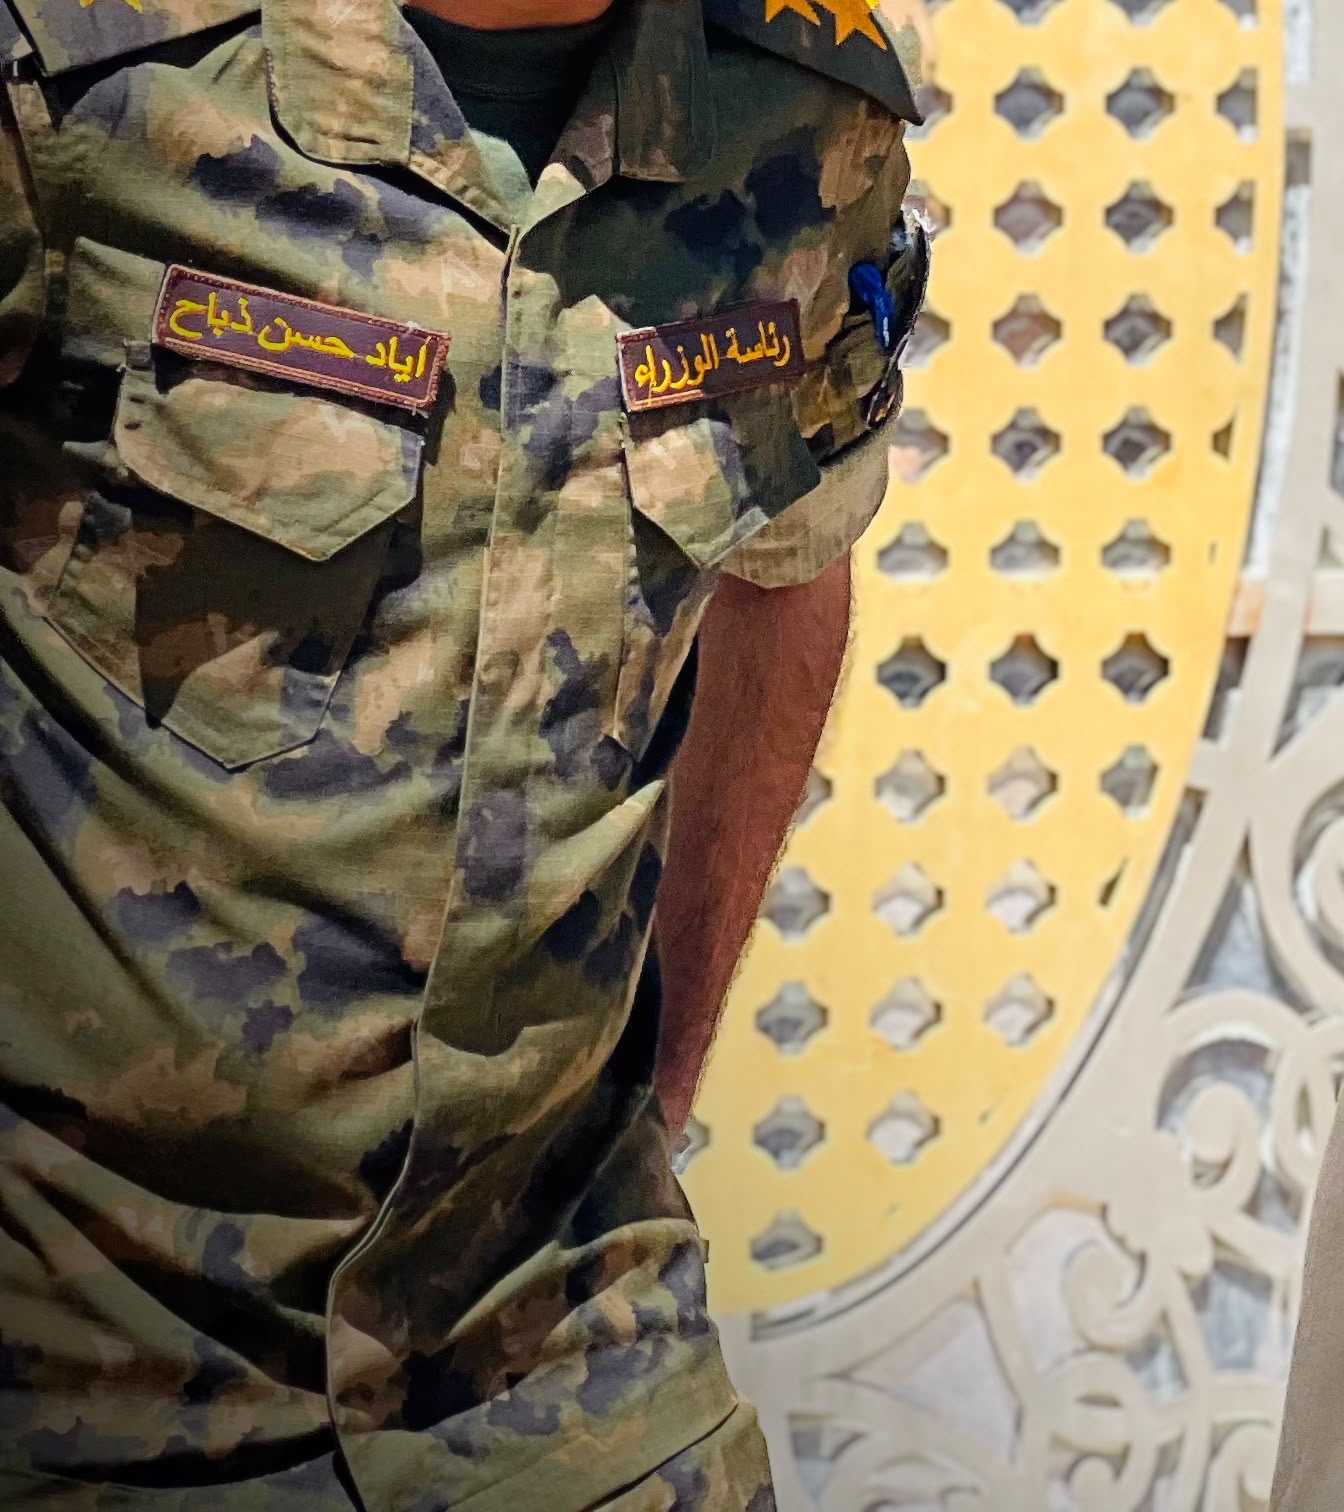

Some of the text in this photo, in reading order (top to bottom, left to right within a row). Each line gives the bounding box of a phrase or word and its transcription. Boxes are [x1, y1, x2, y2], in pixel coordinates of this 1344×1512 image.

[256, 316, 358, 358] حسن
[634, 320, 791, 393] رئاسة الوزراء
